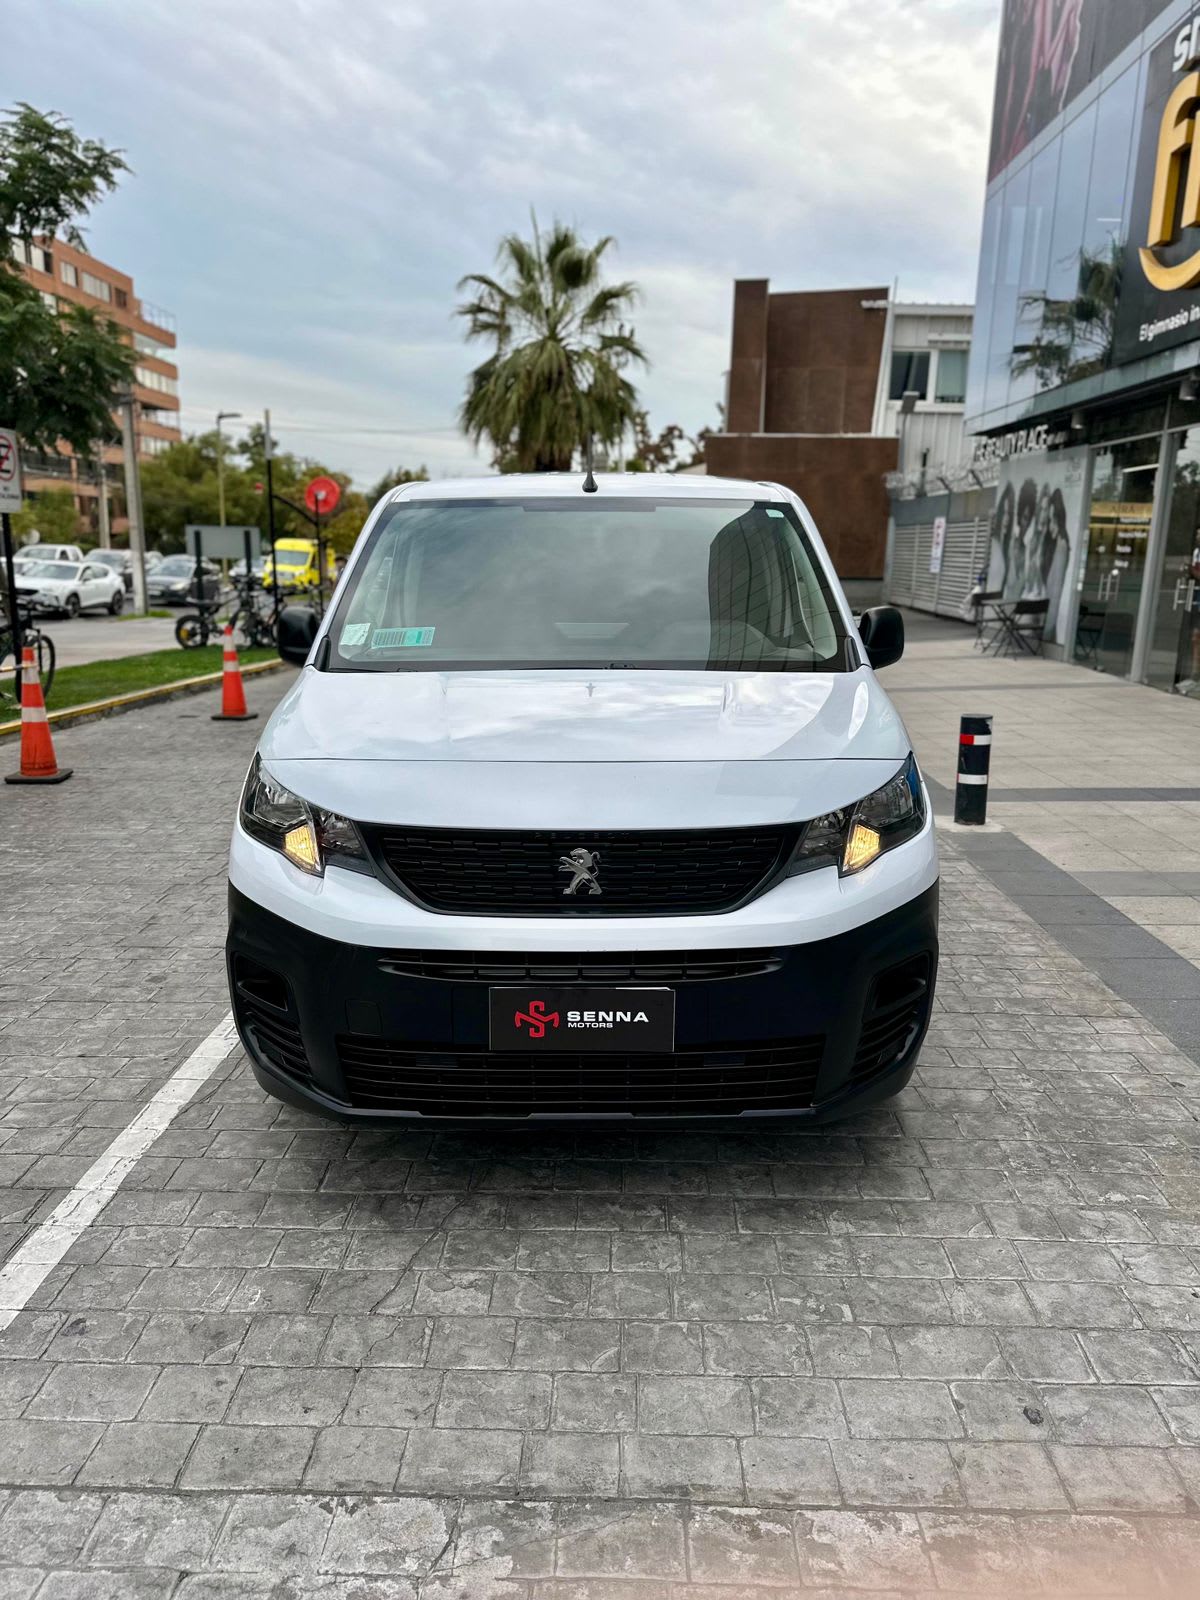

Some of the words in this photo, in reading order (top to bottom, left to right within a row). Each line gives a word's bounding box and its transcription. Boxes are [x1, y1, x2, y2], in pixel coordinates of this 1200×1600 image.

[1139, 323, 1149, 342] El
[1147, 308, 1189, 342] gimnasio
[1016, 424, 1048, 453] PLACE
[566, 1011, 649, 1023] SENNA
